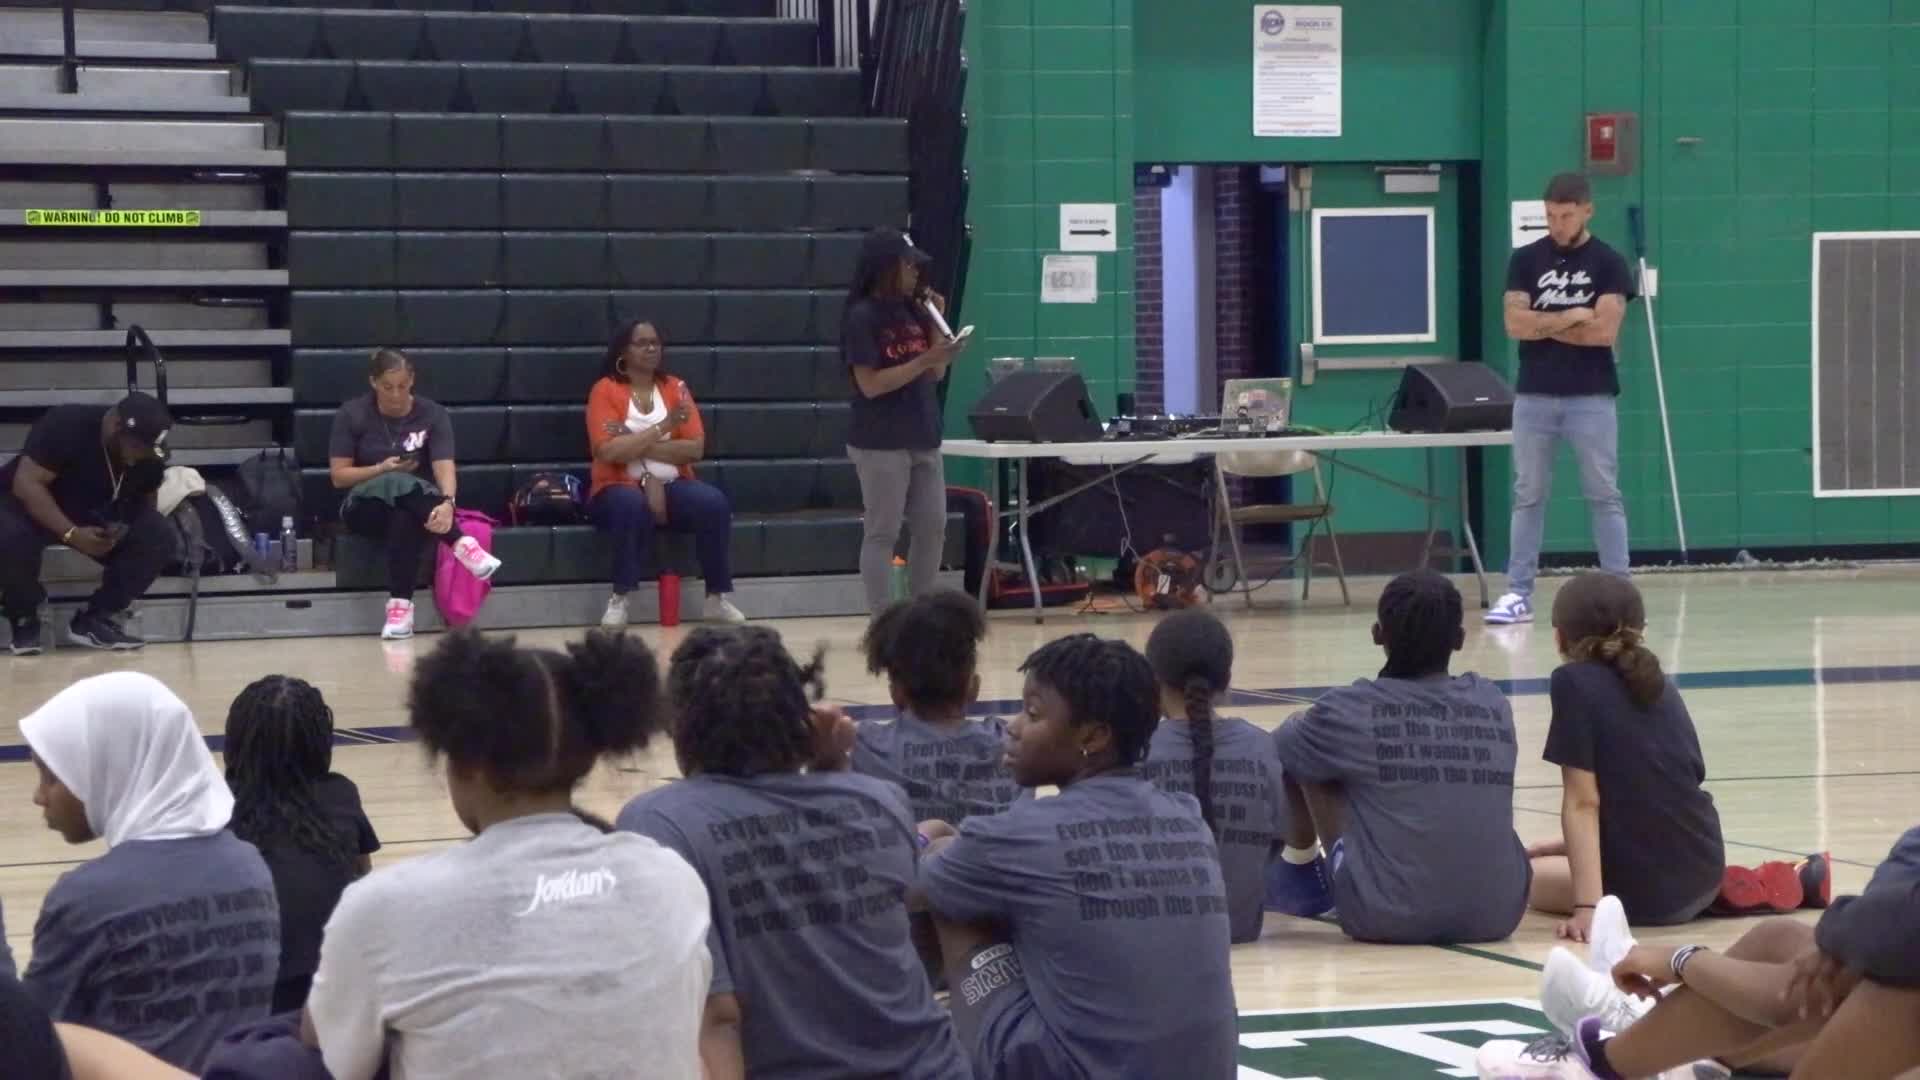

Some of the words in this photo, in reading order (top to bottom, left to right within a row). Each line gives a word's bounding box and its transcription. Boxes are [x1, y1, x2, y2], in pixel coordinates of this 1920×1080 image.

[105, 212, 119, 223] DO
[124, 212, 145, 223] NOT
[149, 211, 184, 223] CLIMB
[1056, 816, 1152, 841] Everybody
[961, 959, 1018, 1006] ARIS
